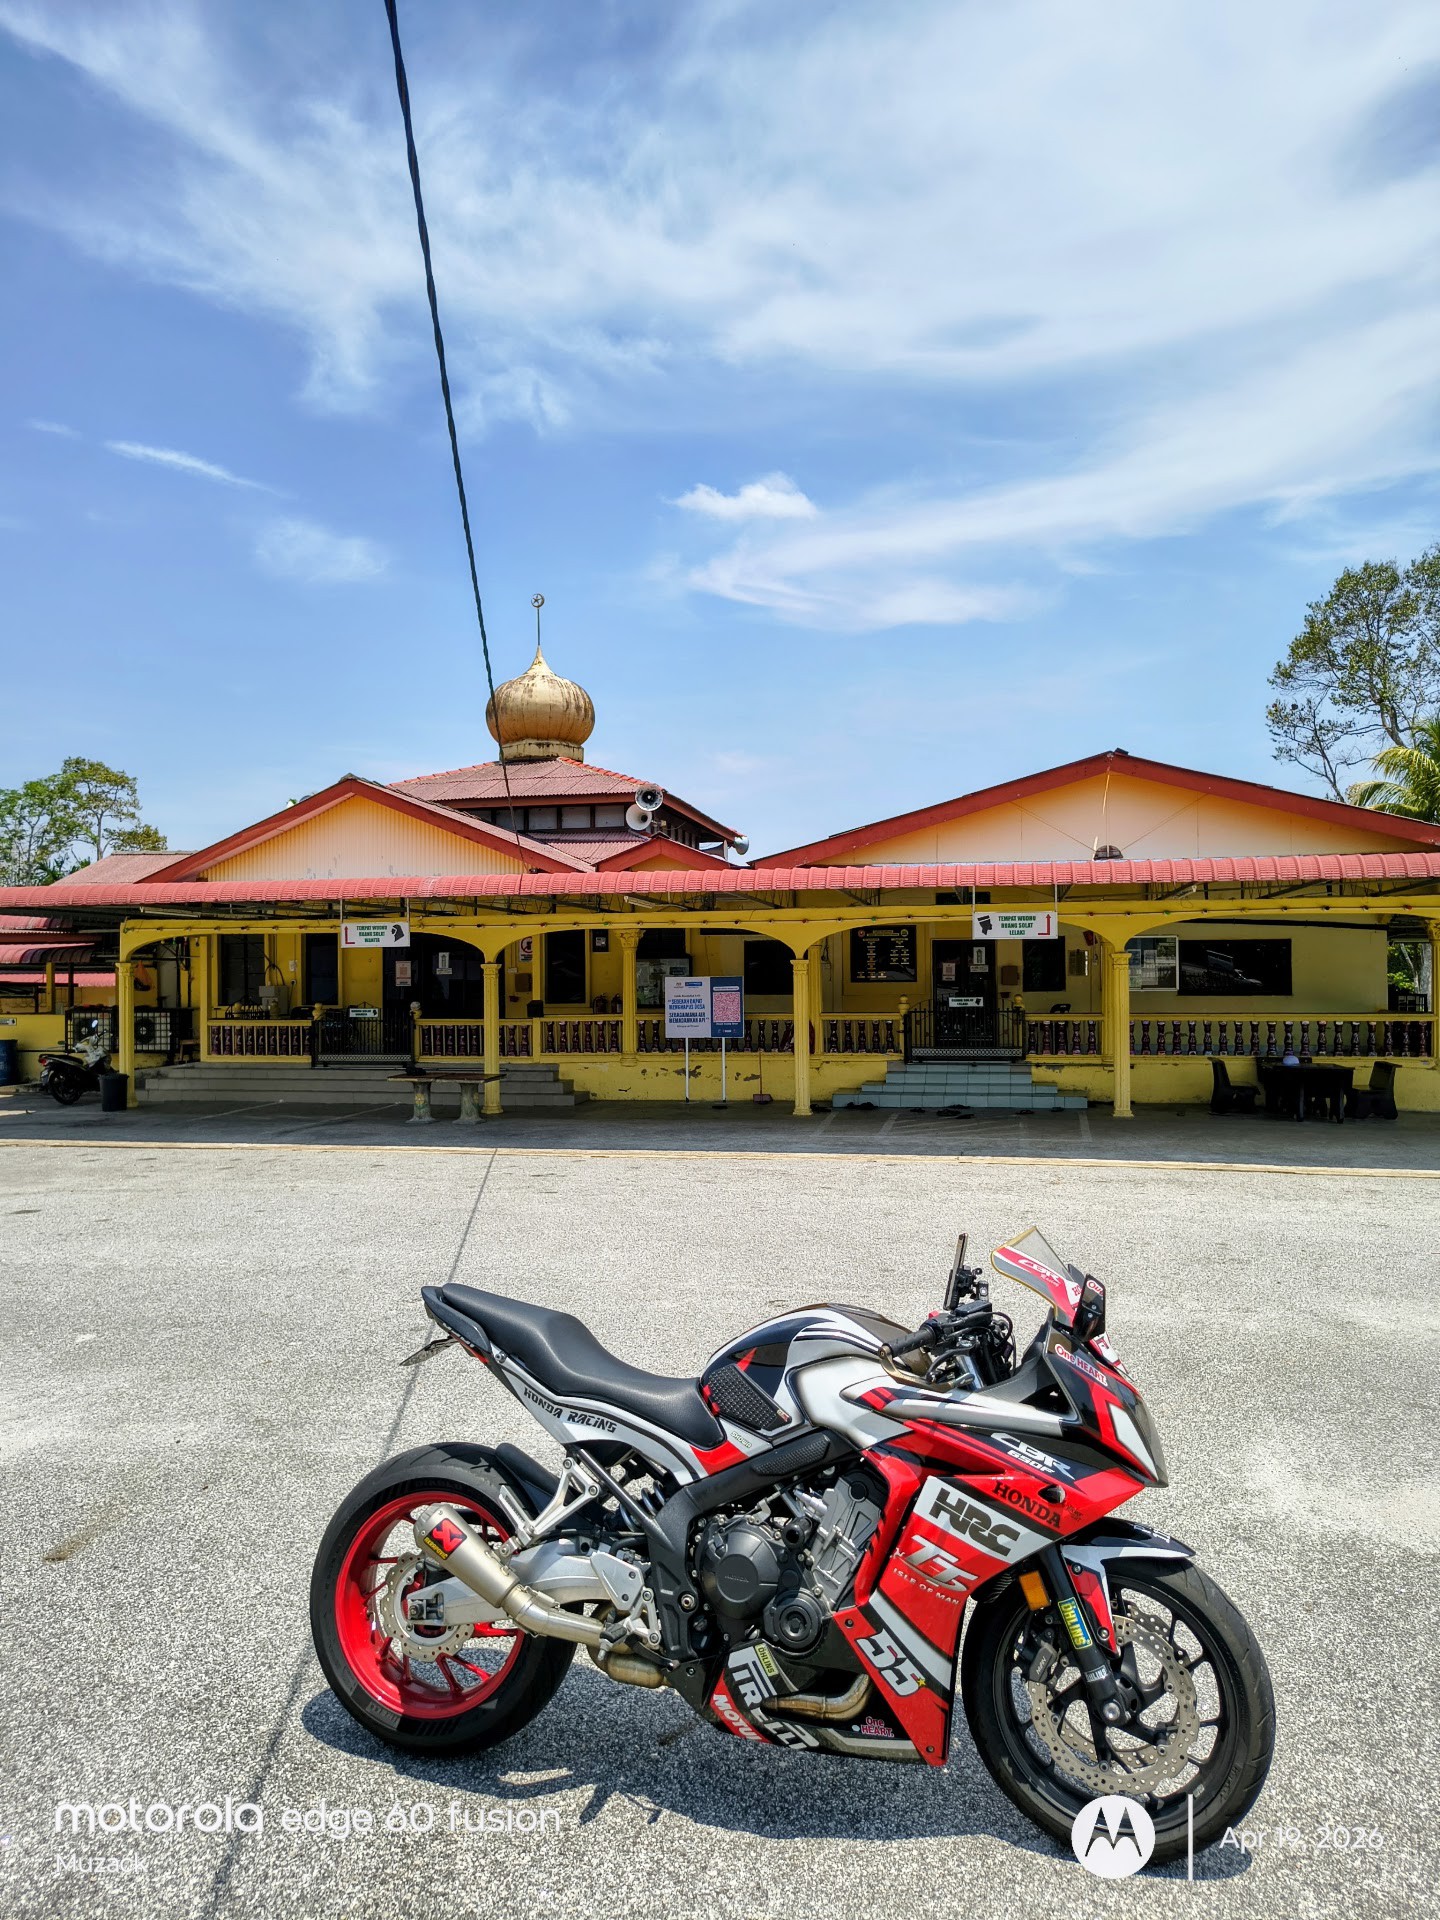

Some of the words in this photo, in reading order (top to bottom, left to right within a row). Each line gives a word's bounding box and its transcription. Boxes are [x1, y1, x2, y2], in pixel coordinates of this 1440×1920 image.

[1055, 1344, 1076, 1364] One
[523, 1387, 563, 1418] HONDA
[991, 1432, 1075, 1480] CBR
[1007, 1449, 1055, 1473] 650F
[929, 1487, 1021, 1557] HRC
[992, 1481, 1061, 1528] HONDA
[893, 1568, 917, 1585] ISLE
[919, 1583, 934, 1594] OF
[935, 1592, 960, 1605] MAN
[856, 1628, 926, 1696] 55
[713, 1693, 763, 1740] MOTUL
[865, 1715, 885, 1728] One
